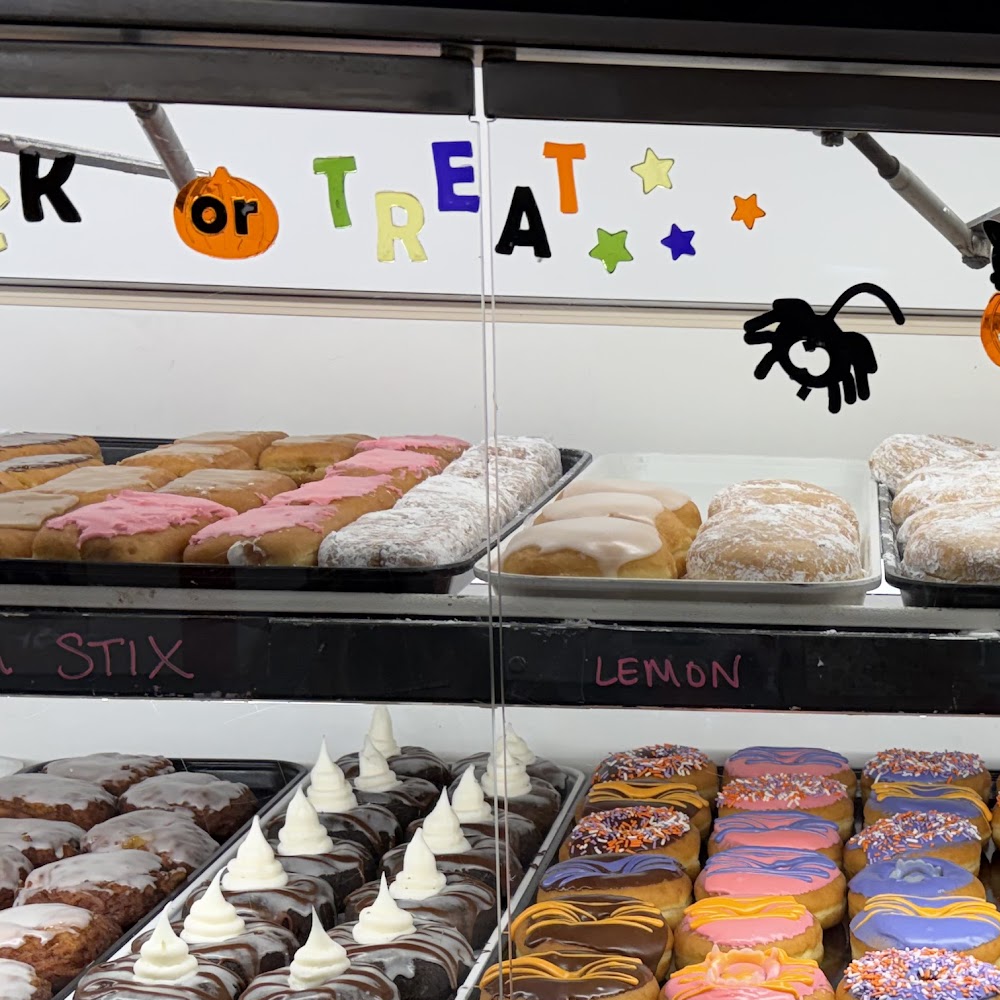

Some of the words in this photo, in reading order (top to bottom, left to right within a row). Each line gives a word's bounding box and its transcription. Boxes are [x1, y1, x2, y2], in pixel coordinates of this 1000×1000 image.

[191, 195, 259, 236] or
[312, 139, 587, 264] TREAT
[55, 631, 195, 681] STIX
[594, 655, 742, 689] LEMON
